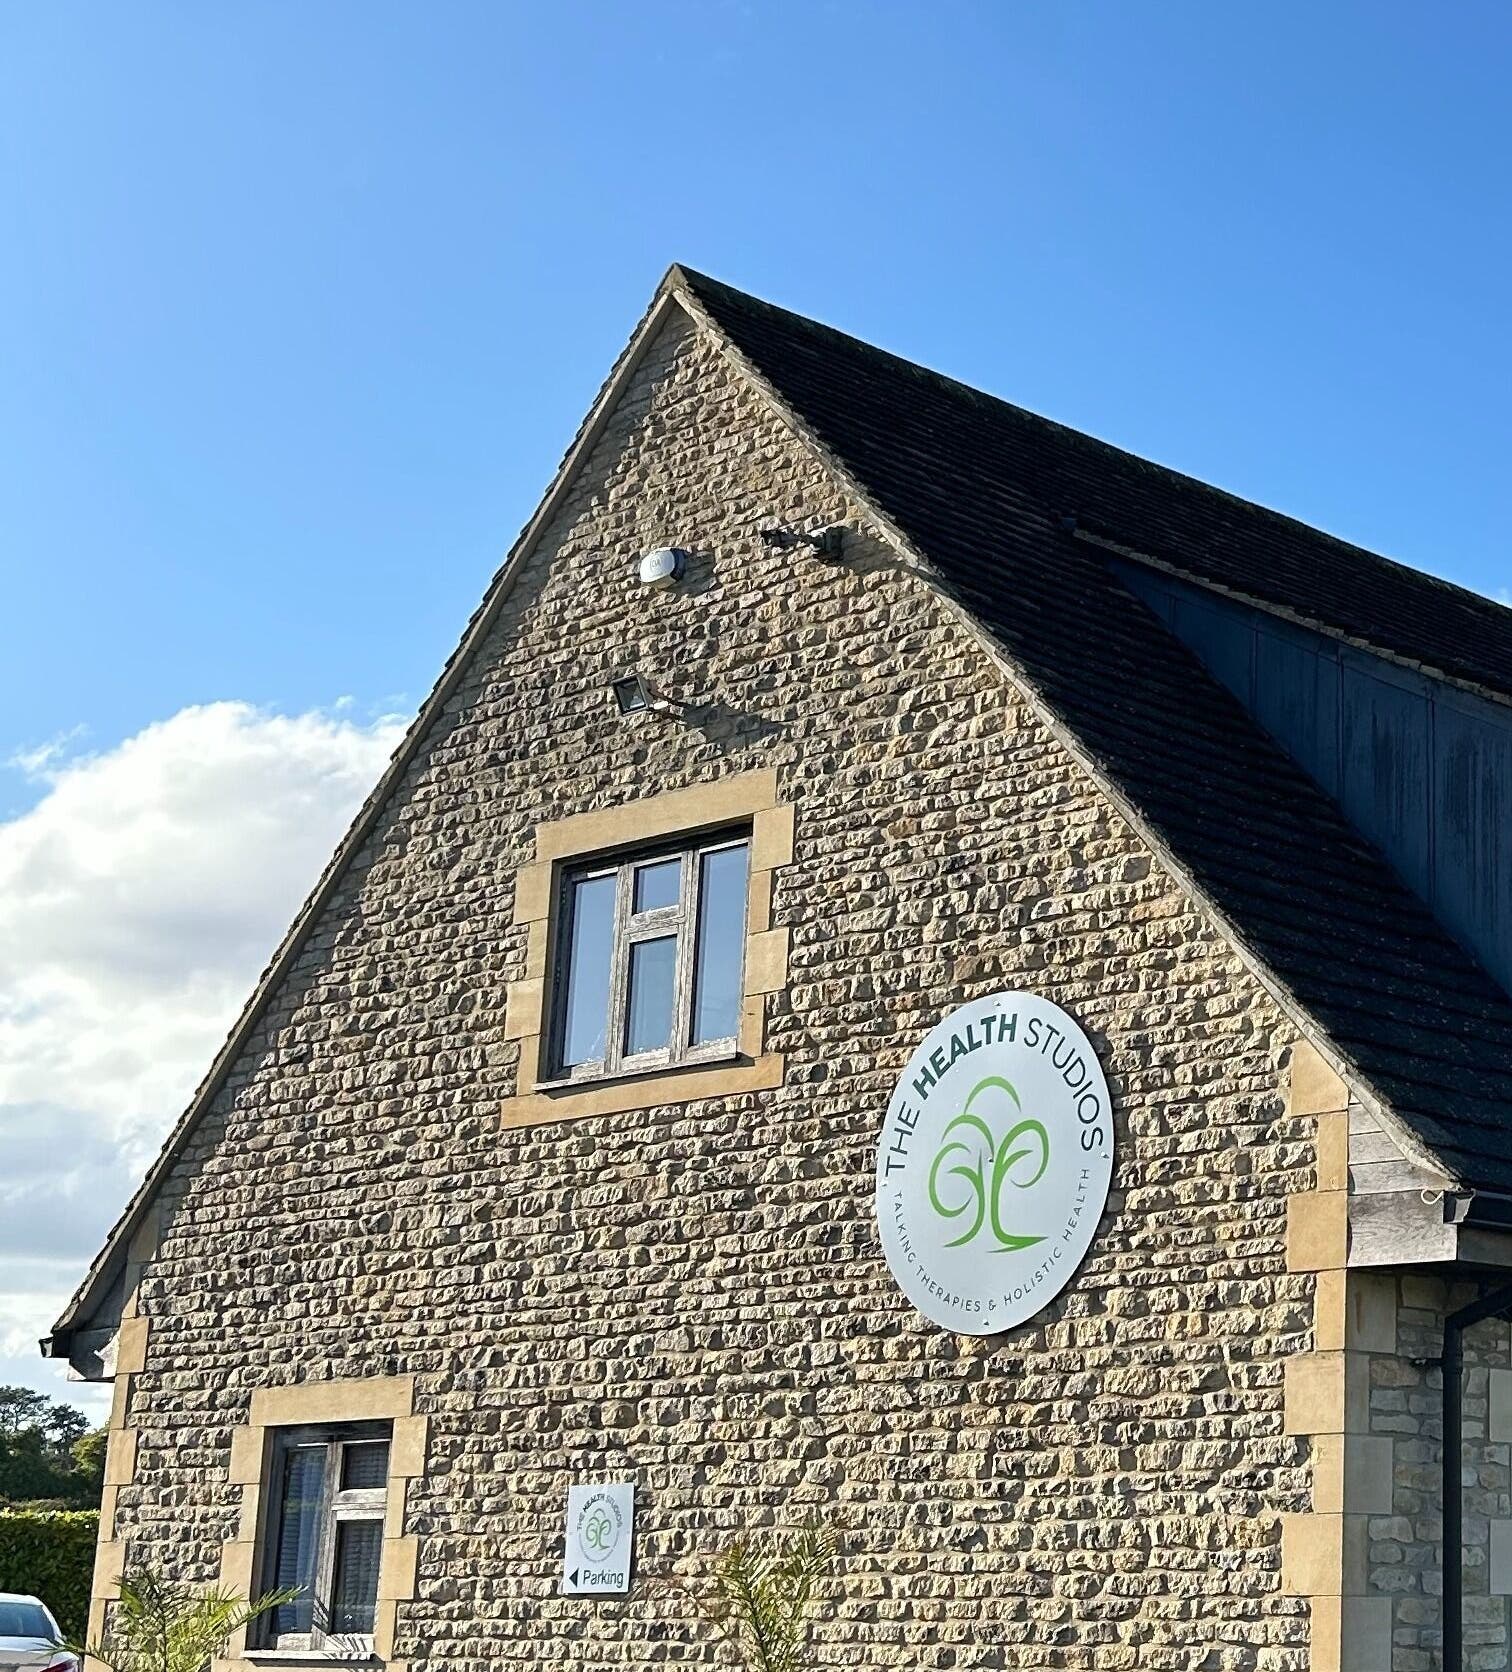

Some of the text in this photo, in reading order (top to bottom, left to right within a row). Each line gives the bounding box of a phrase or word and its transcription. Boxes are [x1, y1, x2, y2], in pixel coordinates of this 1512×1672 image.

[885, 1013, 1104, 1177] THE HEALTH STUDIOS
[894, 1168, 1089, 1312] TALKING THERAPIES & HOLISTIC HEALTH
[583, 1569, 624, 1588] Parking
